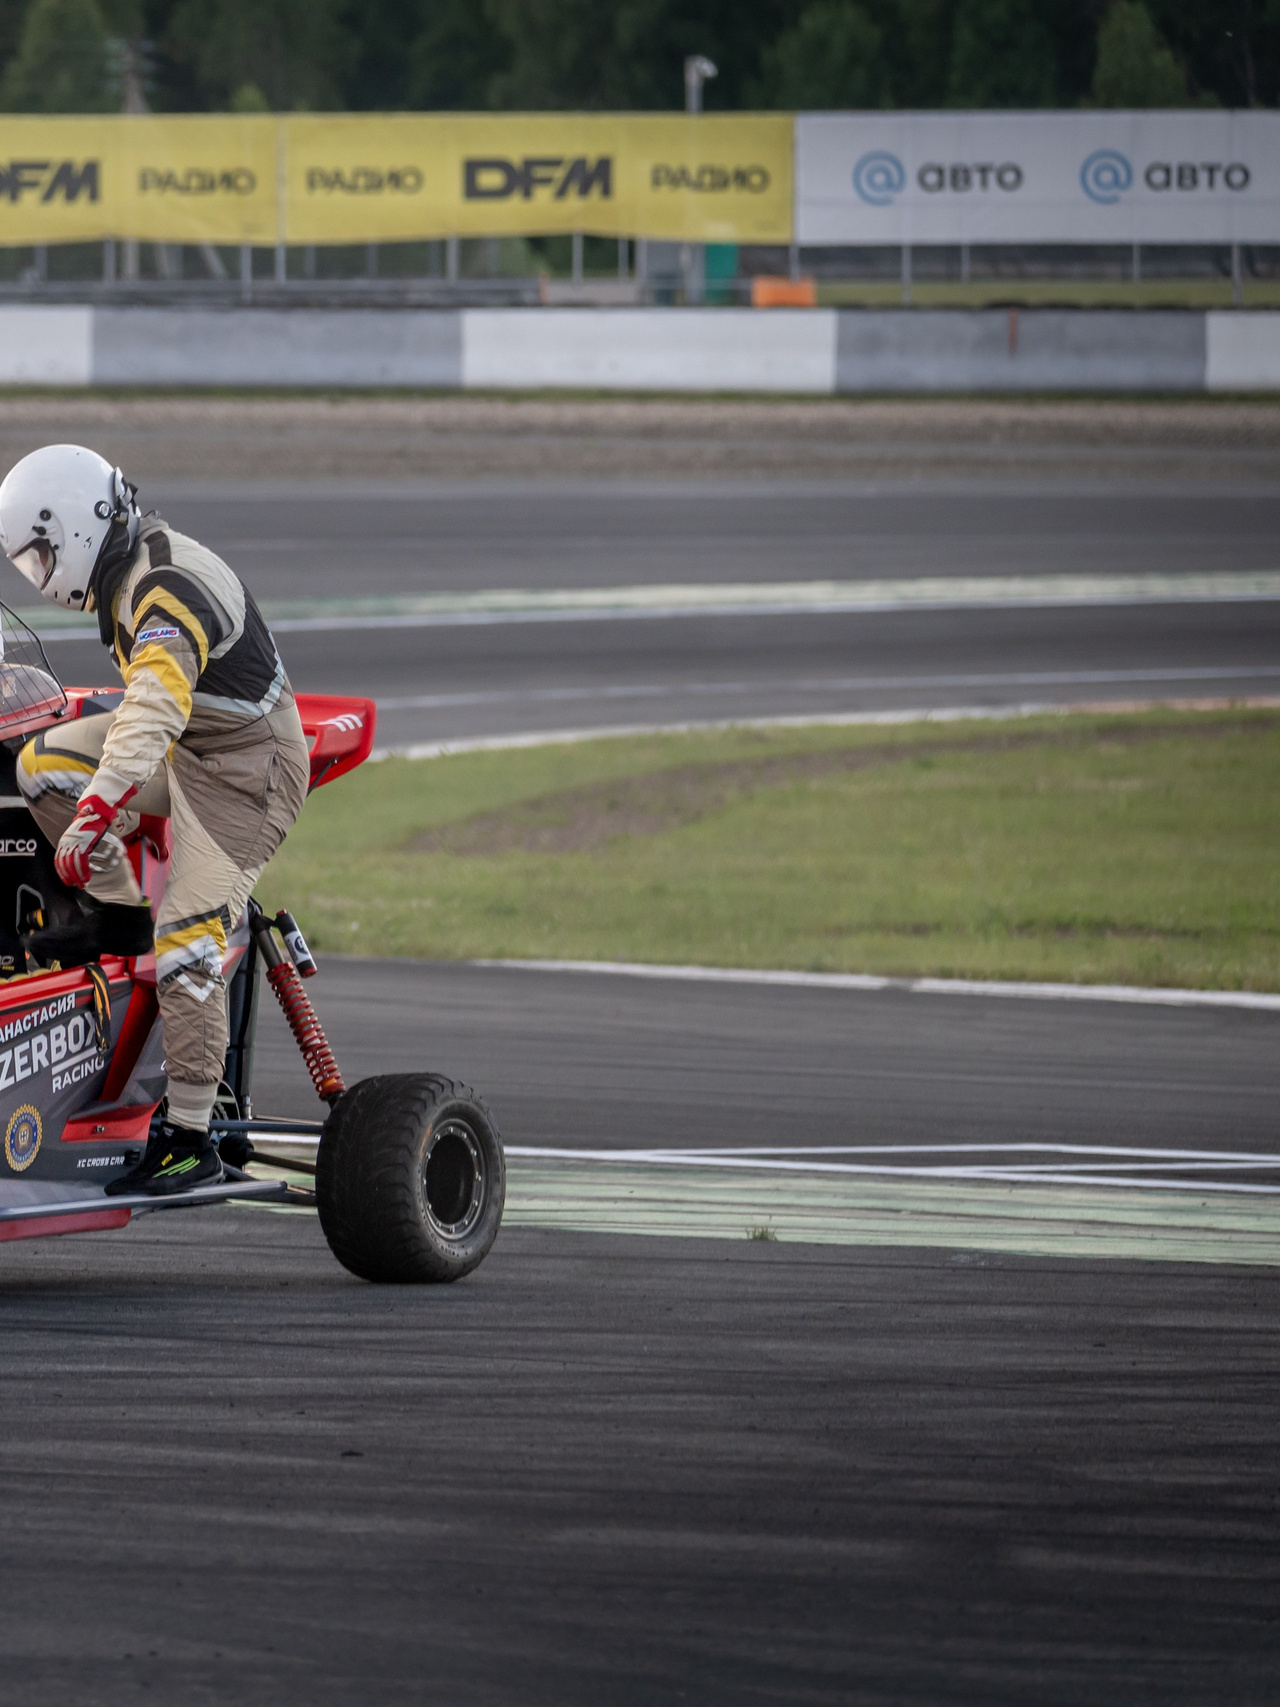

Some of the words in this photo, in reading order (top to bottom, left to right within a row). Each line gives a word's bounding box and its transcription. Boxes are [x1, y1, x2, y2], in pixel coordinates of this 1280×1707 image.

[139, 167, 256, 197] РАДИО
[306, 165, 423, 196] РАДИО
[463, 157, 614, 200] DFM
[651, 164, 771, 194] РАДИО
[52, 1056, 105, 1094] RACING
